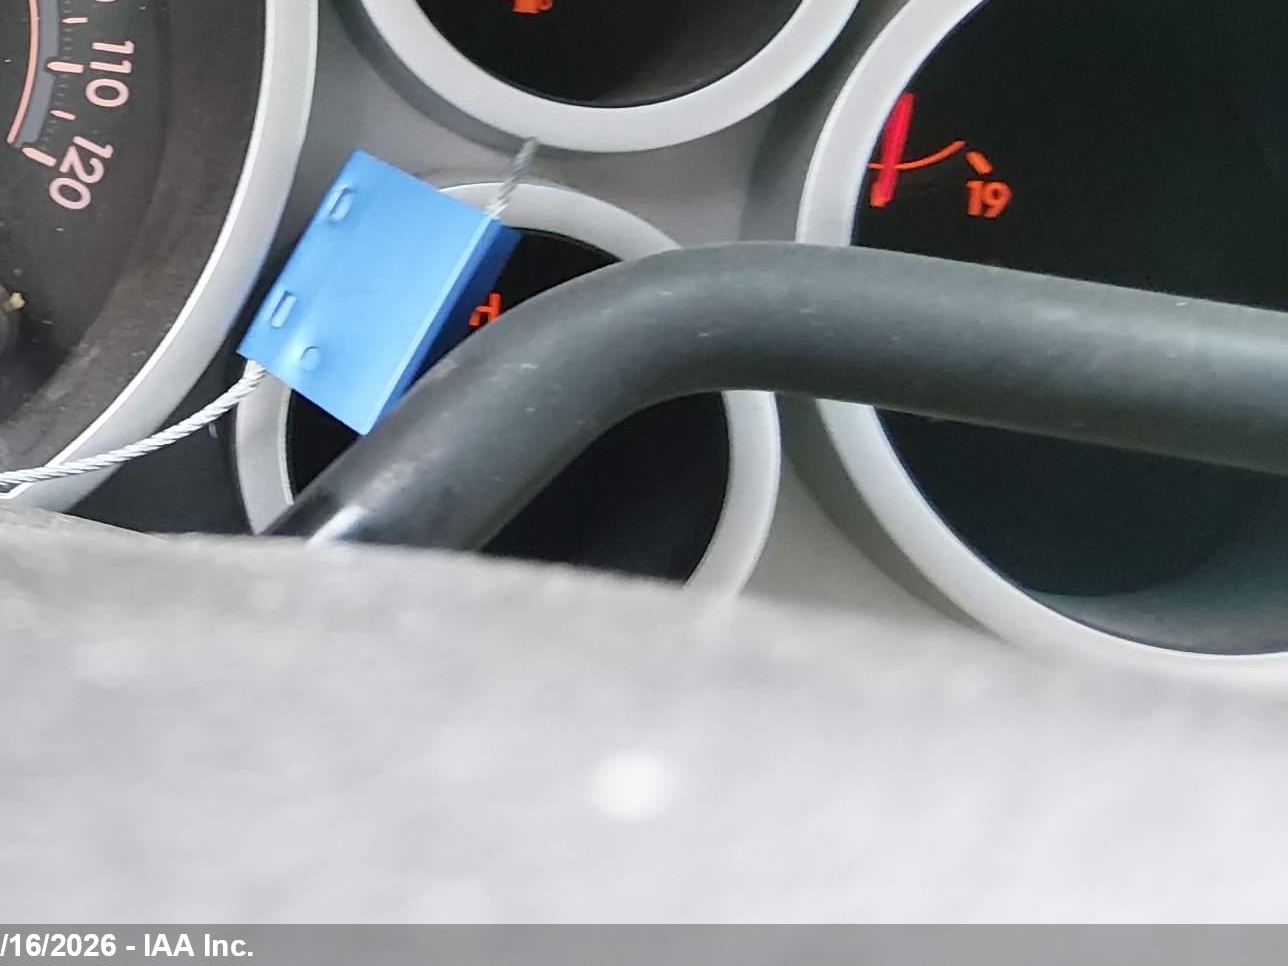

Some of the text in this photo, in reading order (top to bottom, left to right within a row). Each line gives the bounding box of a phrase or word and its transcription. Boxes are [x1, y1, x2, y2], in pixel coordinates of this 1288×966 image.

[86, 41, 134, 107] 110
[50, 136, 113, 209] 120
[967, 181, 1011, 217] 19
